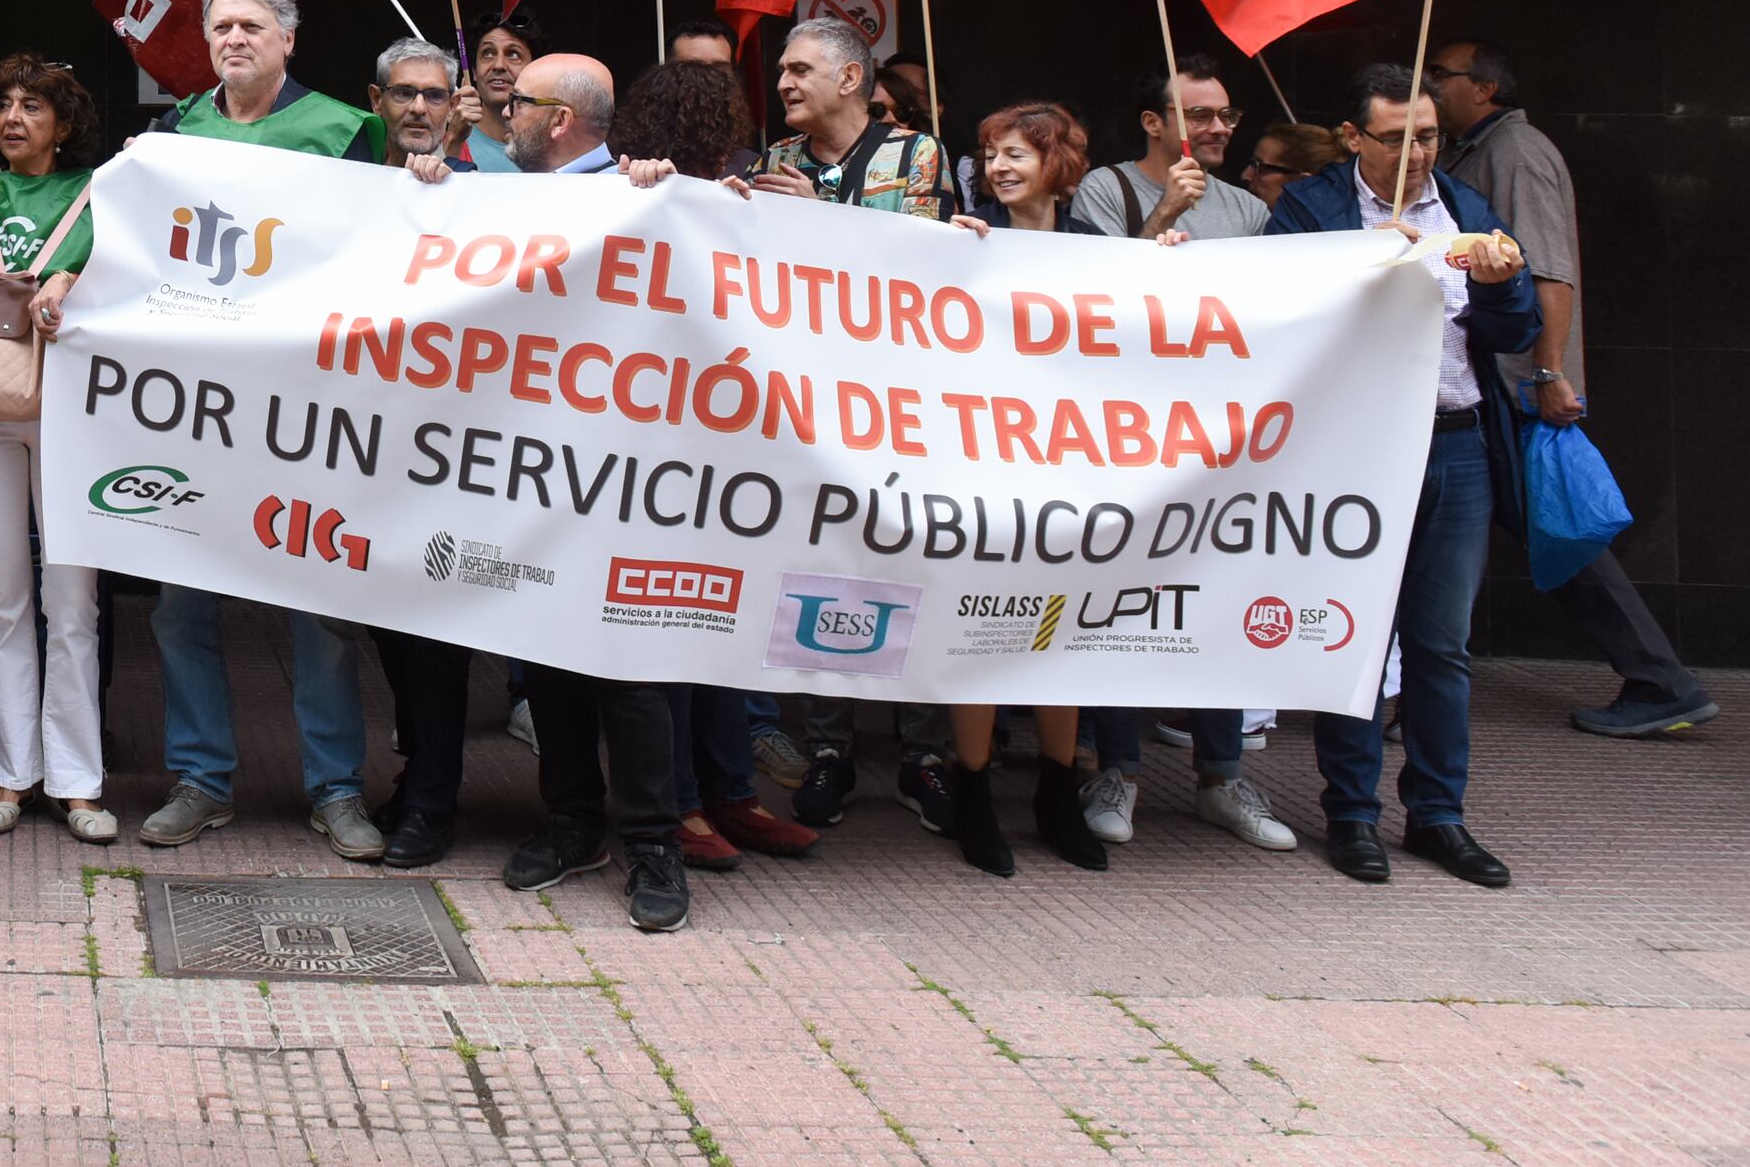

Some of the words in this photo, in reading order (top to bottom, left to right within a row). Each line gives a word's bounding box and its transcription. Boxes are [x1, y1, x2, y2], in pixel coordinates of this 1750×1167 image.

[160, 283, 217, 306] Organismo
[403, 233, 571, 297] POR
[595, 234, 687, 315] EL
[712, 249, 985, 354] FUTURO
[1010, 290, 1121, 357] DE
[1142, 293, 1251, 359] LA
[316, 311, 816, 446] INSPECCIÓN
[836, 379, 928, 458] DE
[941, 390, 1295, 471] TRABAJO
[84, 353, 237, 449] POR
[265, 394, 384, 477] UN
[406, 422, 784, 538] SERVICIO
[808, 471, 1136, 565] PÚBLICO
[1146, 491, 1383, 562] DIGNO
[253, 494, 371, 572] CIG
[460, 539, 494, 559] SINDICATO
[493, 545, 503, 560] DE
[458, 553, 511, 577] INSPECTORES
[510, 562, 522, 579] DE
[522, 564, 555, 586] TRABAJO
[457, 569, 462, 582] Y
[461, 570, 496, 589] SEGURIDAD
[495, 575, 518, 592] SOCIAL
[616, 567, 733, 603] CCOO
[602, 605, 653, 619] servicios
[655, 610, 661, 619] a
[663, 609, 673, 619] la
[675, 609, 736, 626] ciudadanía
[957, 594, 1044, 617] SISLASS
[1250, 605, 1288, 625] UGT
[601, 615, 660, 627] administración
[661, 618, 690, 629] general
[691, 619, 704, 629] del
[705, 623, 735, 634] estado
[963, 629, 1034, 638] SUBINSPECTORES
[980, 620, 1024, 629] SINDICATO
[1025, 620, 1037, 628] DE
[1298, 626, 1327, 634] Servicios
[971, 638, 1018, 647] LABORALES
[1018, 637, 1031, 645] DE
[1064, 643, 1132, 652] INSPECTORES
[1134, 644, 1148, 653] DE
[1151, 645, 1200, 654] TRABAJO
[1073, 634, 1104, 642] UNIÓN
[1106, 634, 1177, 644] PROGRESISTA
[1179, 636, 1193, 644] DE
[1297, 634, 1325, 642] Públicos
[946, 647, 994, 656] SEGURIDAD
[1001, 645, 1028, 655] SALUD
